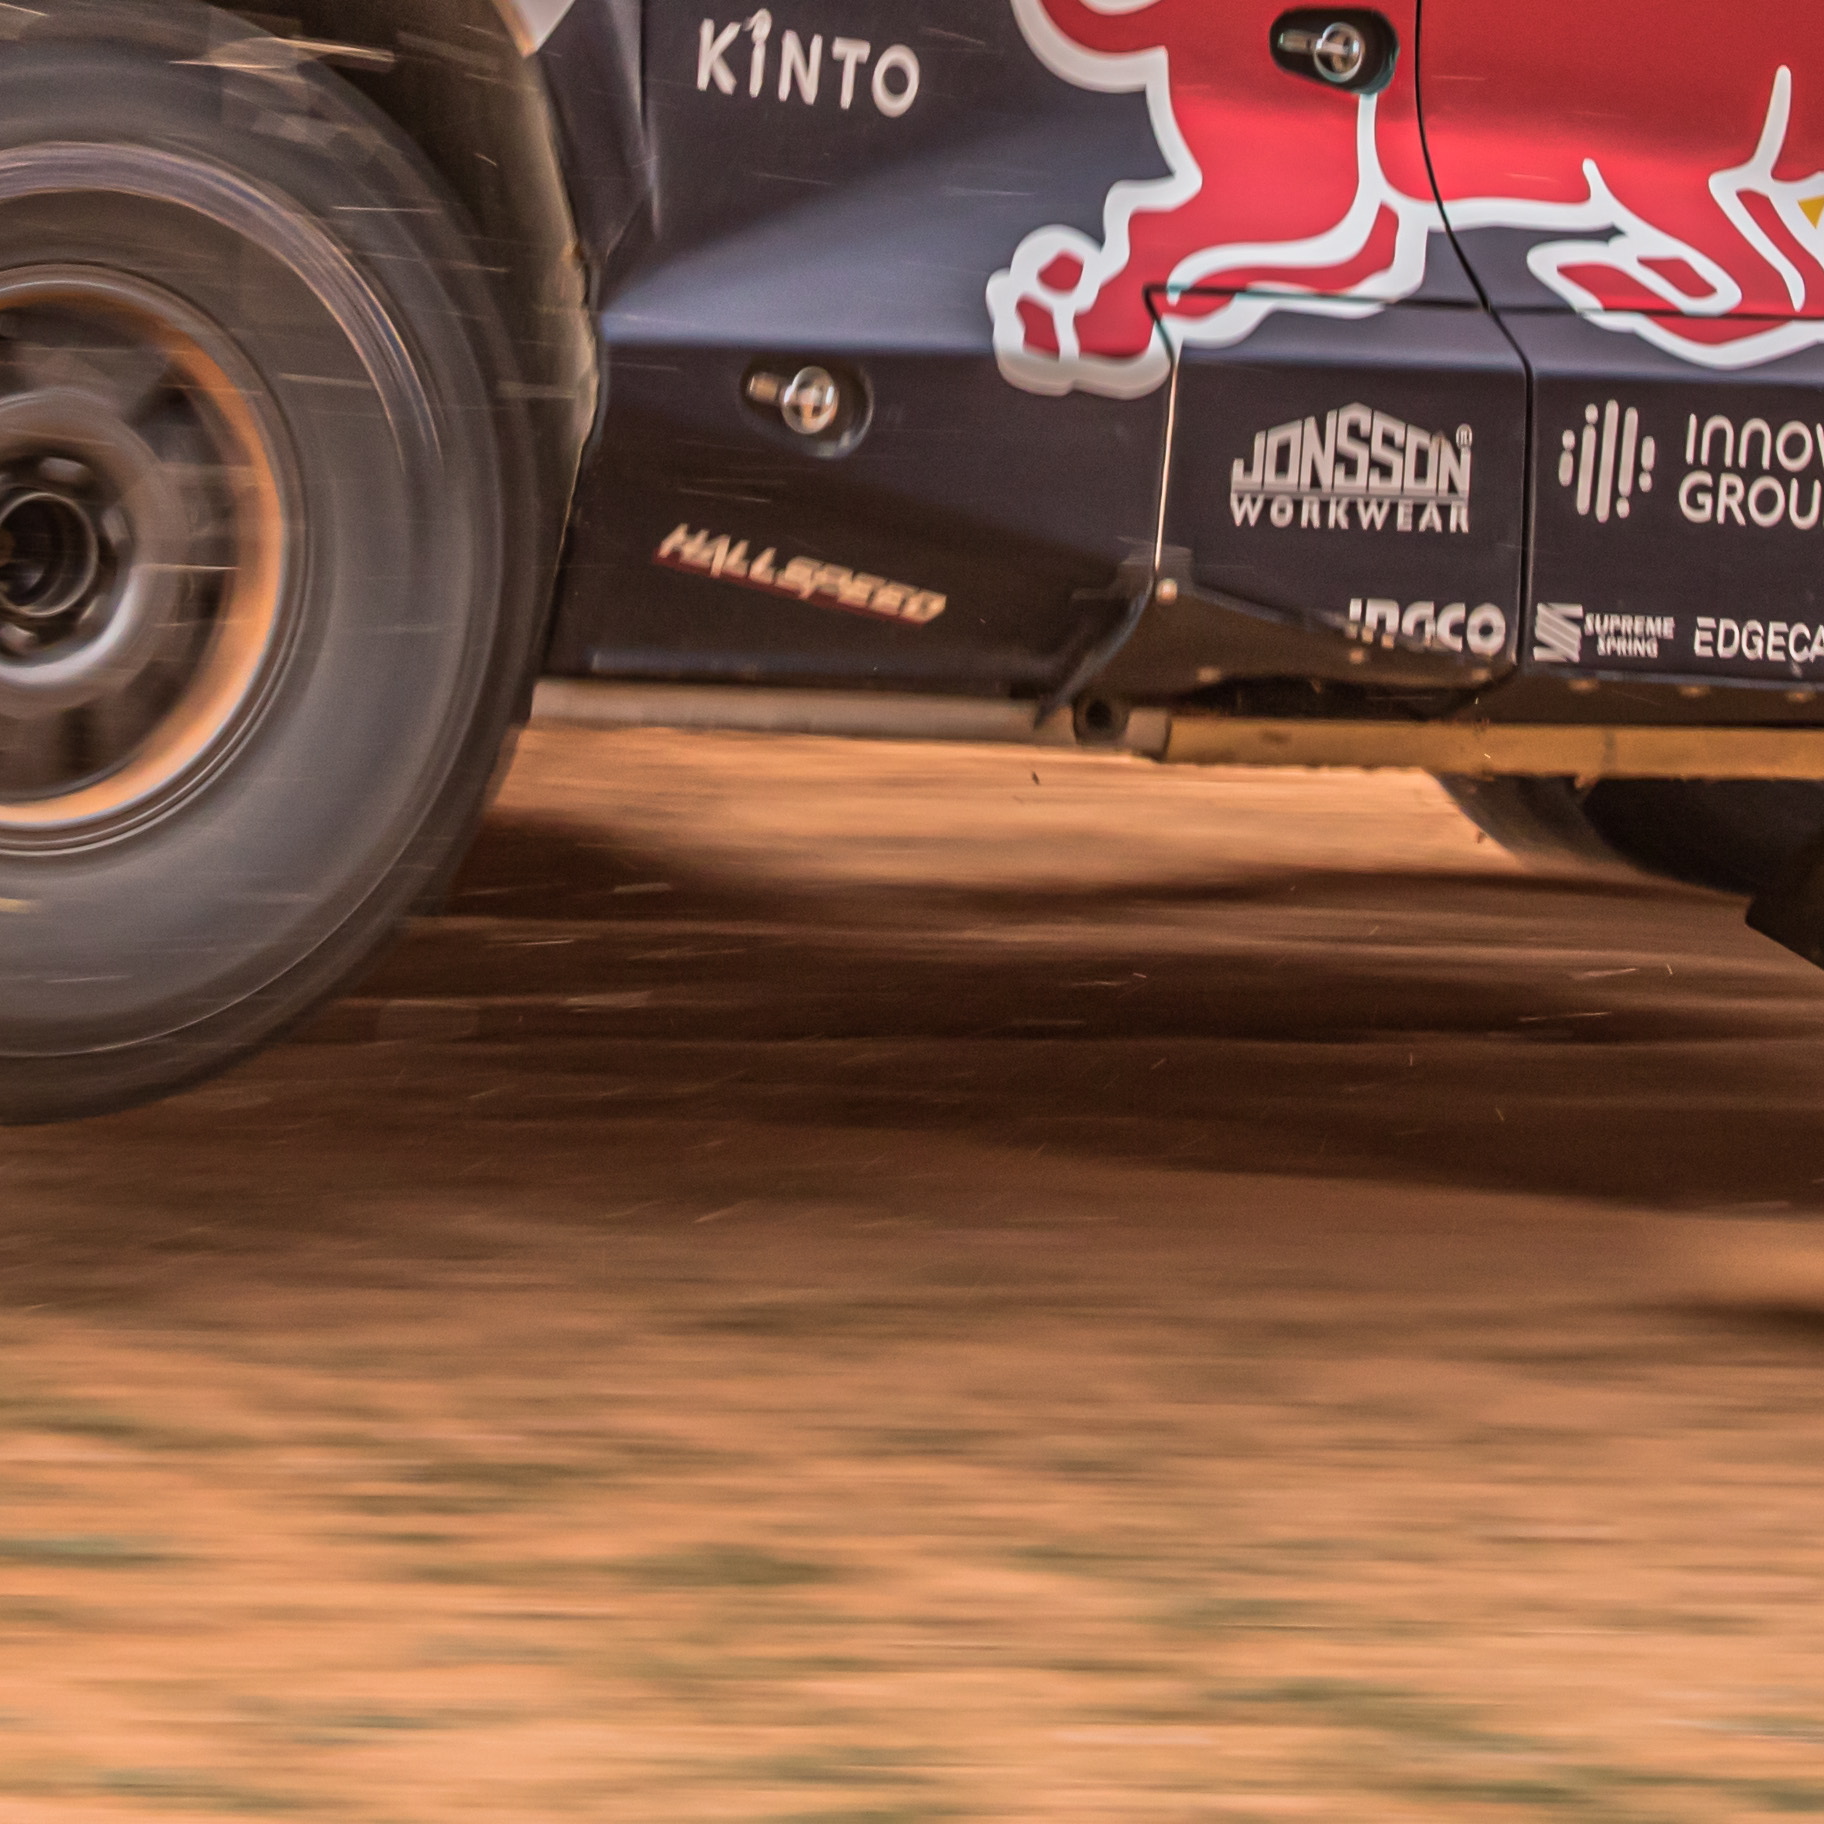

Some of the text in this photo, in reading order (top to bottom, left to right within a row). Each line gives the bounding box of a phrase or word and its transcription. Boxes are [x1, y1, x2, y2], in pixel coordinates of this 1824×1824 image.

[1231, 402, 1471, 495] JONSSON
[1229, 493, 1470, 533] WORKWEAR
[1585, 613, 1675, 640] SUPREME
[1597, 636, 1659, 659] SPRING
